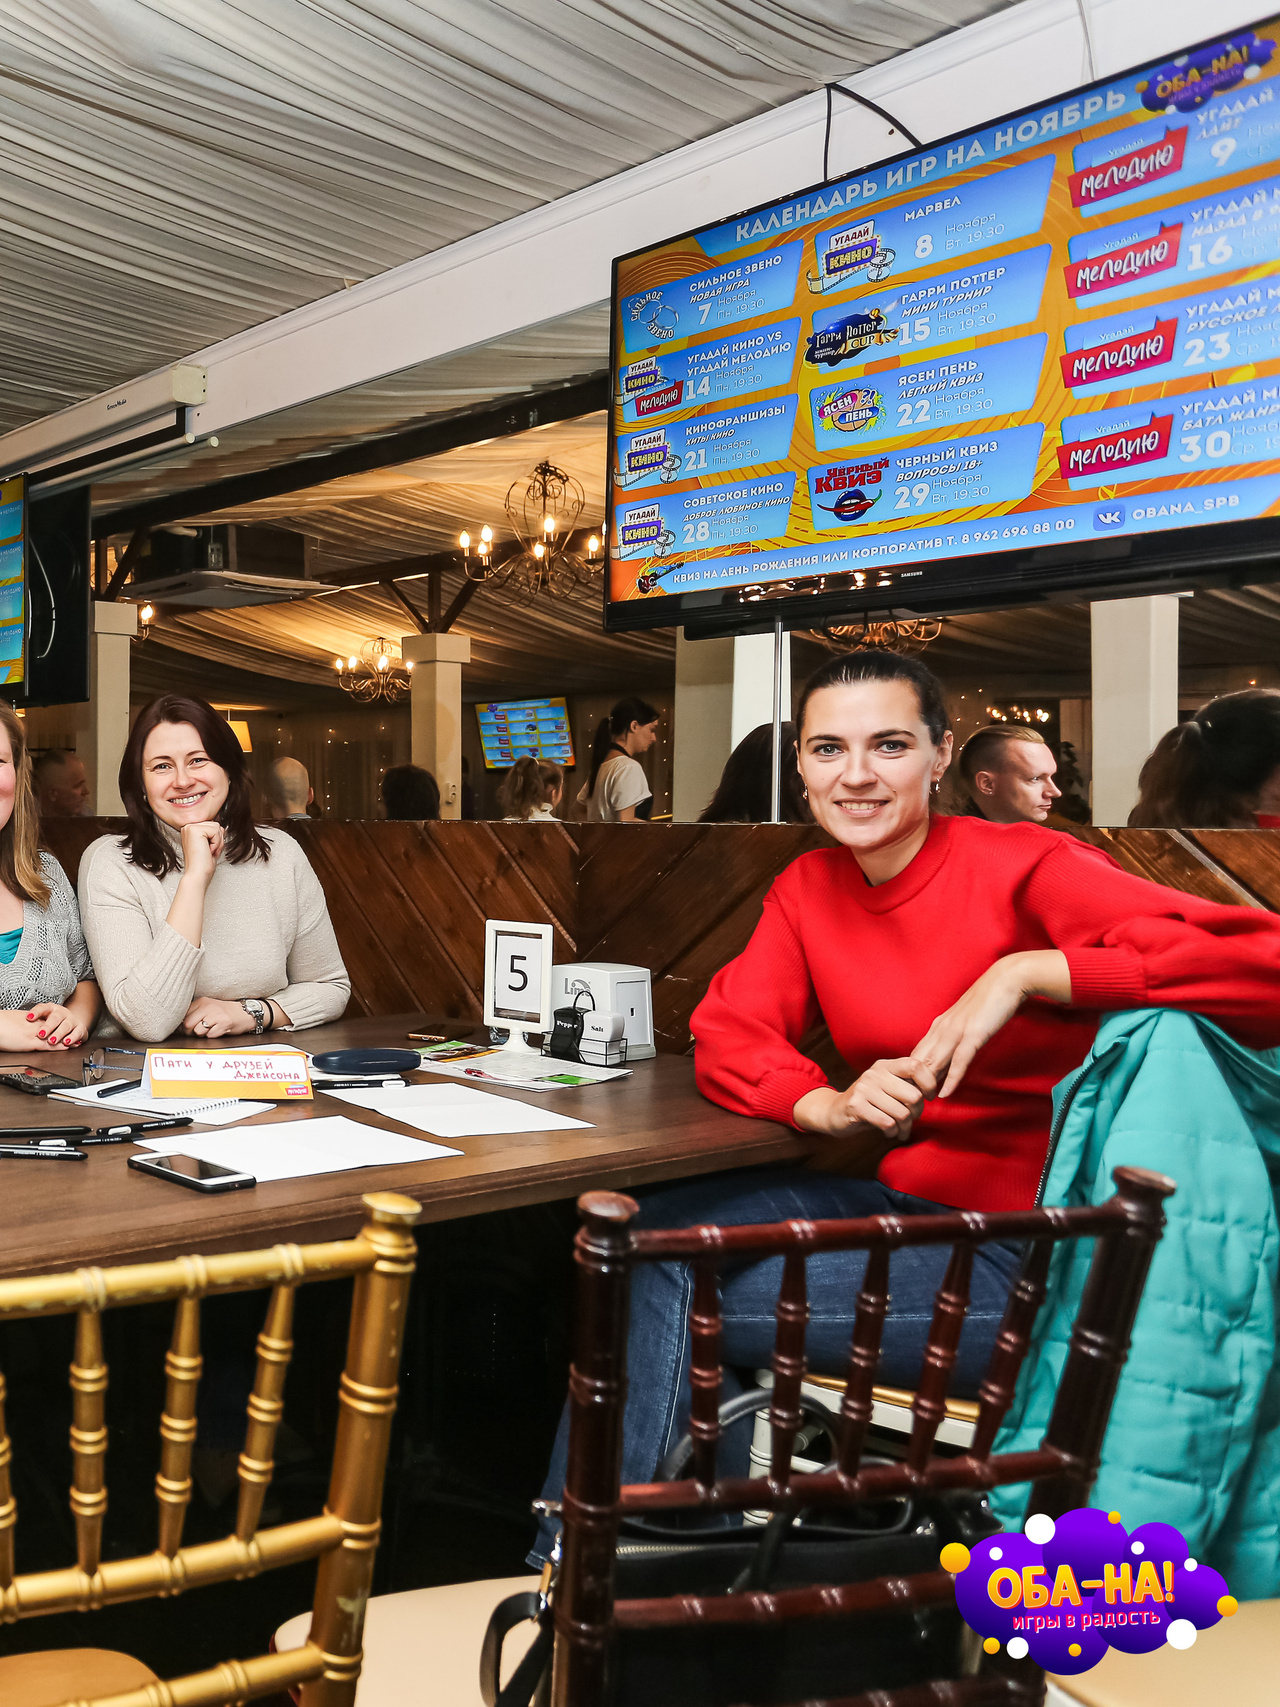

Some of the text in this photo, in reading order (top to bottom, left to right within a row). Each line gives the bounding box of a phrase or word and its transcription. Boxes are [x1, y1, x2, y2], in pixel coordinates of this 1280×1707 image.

[1211, 137, 1237, 167] 9
[736, 90, 1126, 242] КАЛЕНДАРЬ ИГР НА НОЯБРЬ
[904, 195, 962, 223] МАРВЕЛ
[1191, 189, 1267, 223] УГАДАЙ
[834, 227, 870, 247] УГАДАЙ
[914, 212, 996, 259] 8 Ноября
[968, 223, 1005, 244] 19:30
[829, 245, 873, 270] КИНО
[1187, 235, 1233, 272] 16
[689, 255, 783, 292] СИЛЬНОЕ ЗВЕНО
[900, 267, 1006, 305] ГАРРИ ПОТТЕР
[689, 278, 751, 304] НОВАЯ ИГРА
[901, 285, 993, 318] МИНИ ТУРНИР
[1186, 288, 1262, 319] УГАДАЙ
[631, 291, 663, 321] СИЛЬНОЕ
[698, 288, 756, 325] 7 Ноября
[736, 298, 765, 316] 19:30
[1186, 305, 1268, 334] РУССКОЕ
[647, 322, 674, 339] ЗВЕНО
[898, 302, 988, 346] 15 Ноября
[959, 312, 997, 332] 19:30
[687, 331, 782, 364] УГАДАЙ КИНО VS
[851, 335, 875, 348] CUP
[1183, 331, 1231, 367] 23
[630, 360, 654, 373] УГАДАЙ
[687, 341, 792, 378] УГАДАЙ МЕЛОДИЮ
[627, 375, 656, 390] КИНО
[685, 364, 754, 400] 14 Ноября
[733, 373, 762, 390] 19:30
[898, 360, 978, 387] ЯСЕН ПЕНЬ
[898, 372, 984, 400] ЛЕГКИЙ КВИЗ
[823, 395, 853, 416] ЯСЕН
[845, 408, 873, 423] ПЕНЬ
[896, 386, 984, 428] 22 Ноября
[956, 398, 993, 416] 19:30
[1181, 388, 1257, 416] УГАДАЙ
[685, 405, 786, 436] КИНОФРАНШИЗЫ
[1181, 403, 1280, 431] БАТЛ ЖАНР
[634, 433, 662, 448] УГАДАЙ
[685, 428, 736, 446] ХИТЫ КИНО
[1179, 420, 1280, 463] 30 Нояб
[630, 450, 664, 468] КИНО
[684, 438, 751, 472] 21 Ноября
[731, 448, 760, 463] 19:30
[896, 441, 998, 469] ЧЕРНЫЙ КВИЗ
[815, 470, 882, 494] КВИЗ
[896, 460, 984, 483] ВОПРОСЫ 18+
[683, 482, 783, 509] СОВЕТСКОЕ КИНО
[893, 472, 982, 510] 29 Ноября
[953, 485, 990, 502] 19:30
[628, 508, 656, 522] УГАДАЙ
[682, 496, 791, 523] ДОБРОЕ ЛЮБИМОЕ КИНО
[1132, 495, 1240, 521] OBANA_SPB
[624, 524, 658, 542] КИНО
[682, 514, 749, 544] 28 Ноября
[729, 524, 758, 538] 19:30
[673, 572, 701, 584] КВИЗ
[703, 569, 719, 579] НА
[720, 564, 750, 578] ДЕНЬ
[752, 554, 819, 574] РОЖДЕНИЯ
[822, 551, 849, 563] ИЛИ
[852, 537, 942, 558] КОРПОРАТИВ
[961, 533, 970, 544] 8
[974, 530, 998, 542] 962
[1002, 526, 1029, 538] 696
[1032, 522, 1051, 534] 88
[1055, 518, 1075, 531] 00
[507, 954, 529, 992] 5
[556, 1020, 578, 1029] Peppr
[590, 1025, 604, 1033] Salt
